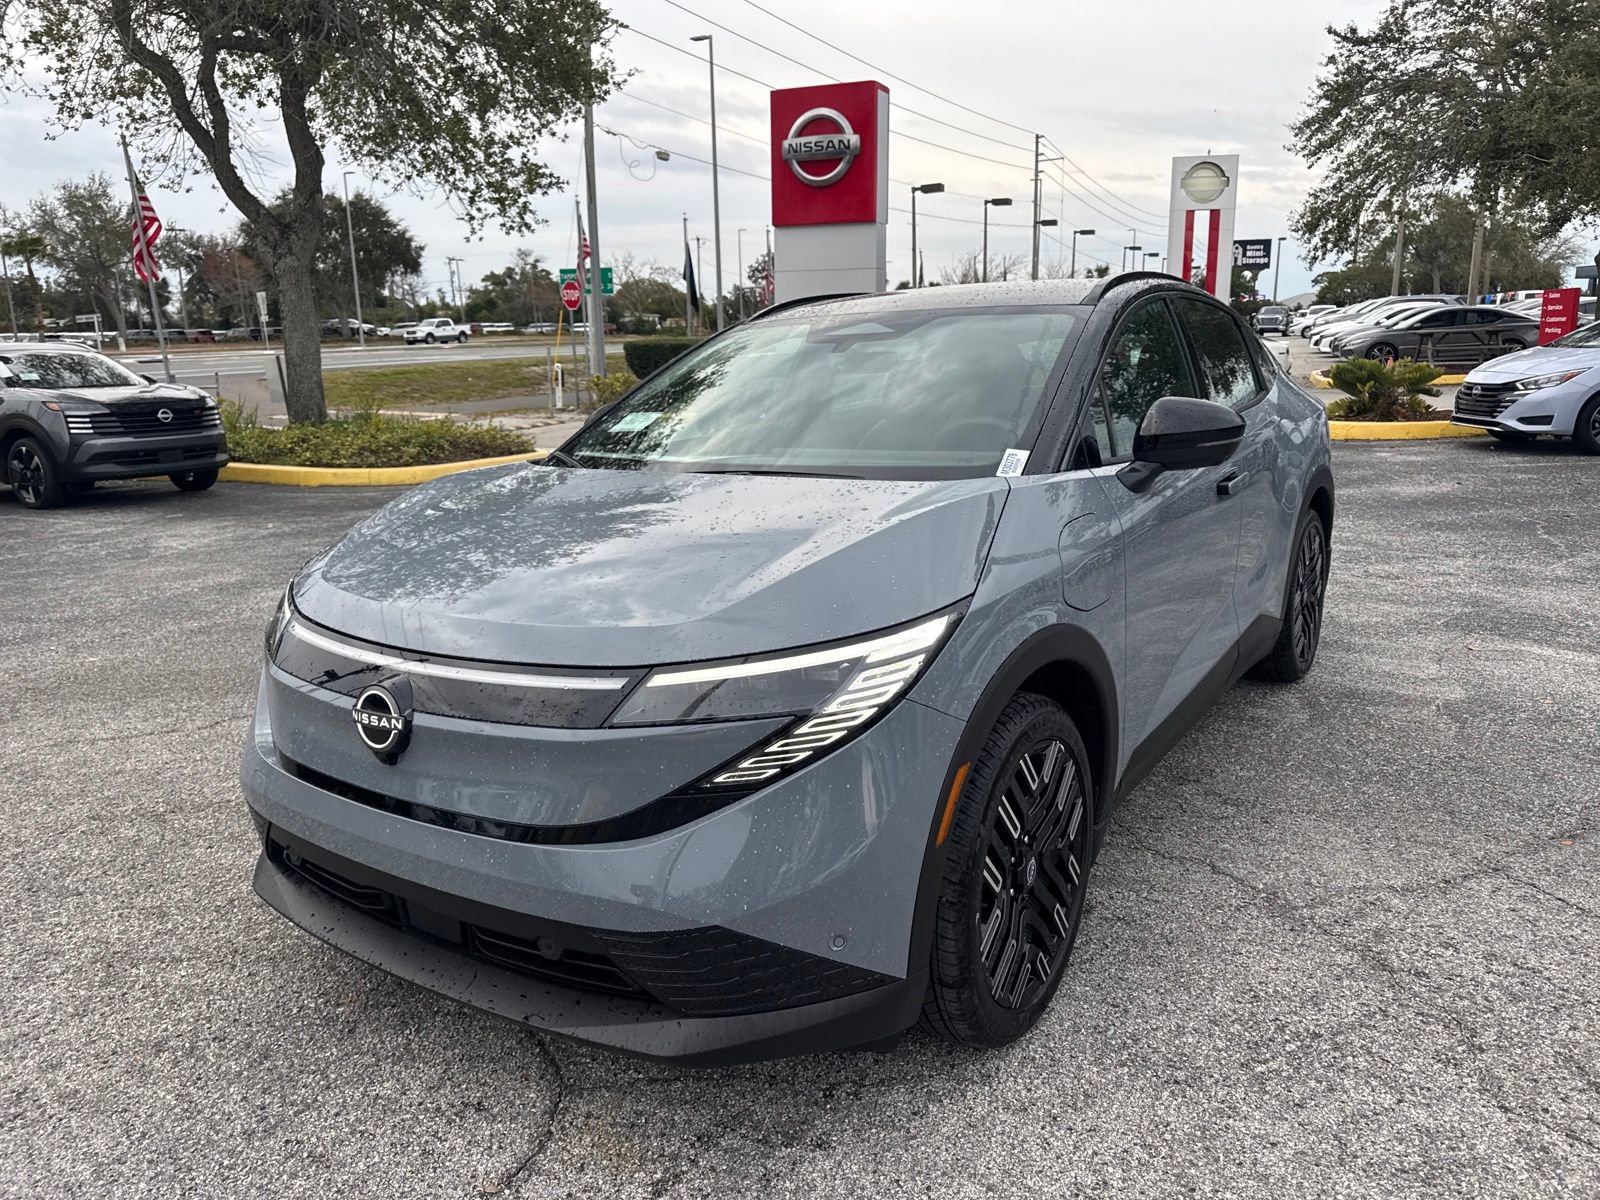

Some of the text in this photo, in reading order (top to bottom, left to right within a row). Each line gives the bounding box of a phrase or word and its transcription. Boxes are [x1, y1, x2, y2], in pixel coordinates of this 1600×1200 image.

[787, 139, 851, 154] NISSAN
[1242, 257, 1269, 265] Storage
[563, 289, 580, 301] STOP
[352, 709, 402, 730] NISSAN
